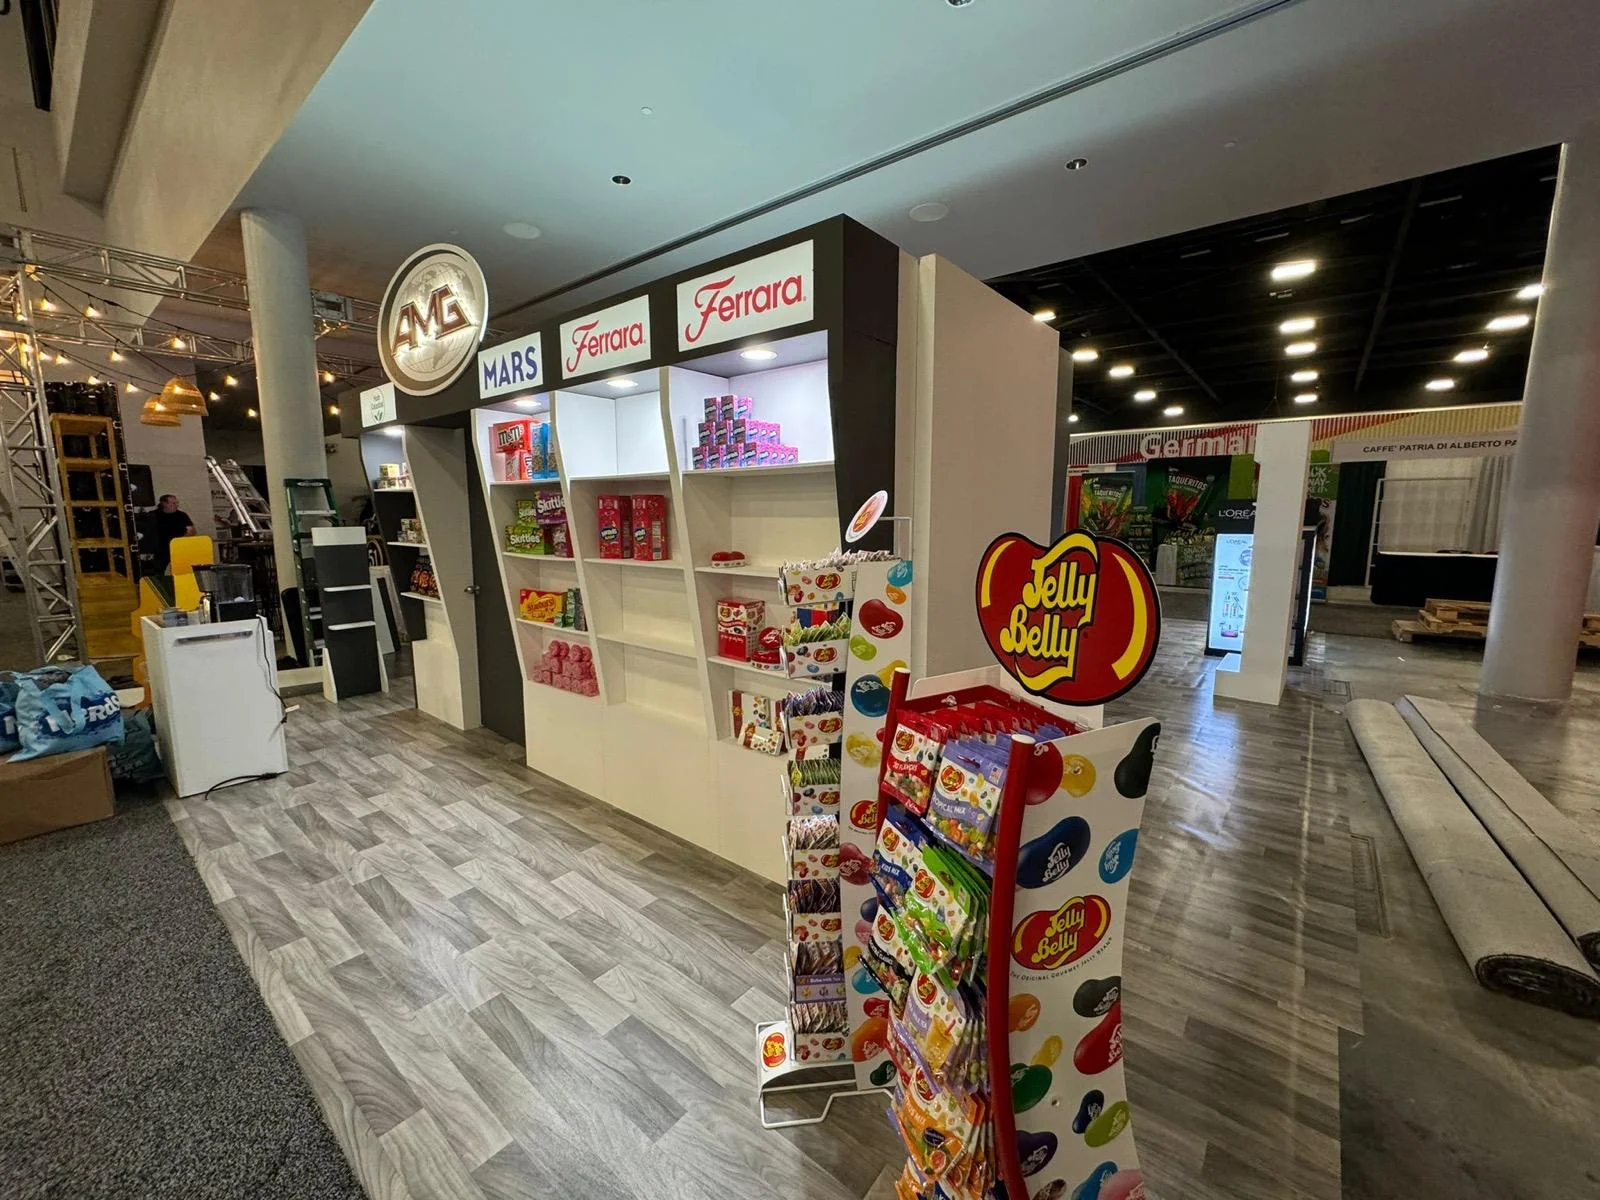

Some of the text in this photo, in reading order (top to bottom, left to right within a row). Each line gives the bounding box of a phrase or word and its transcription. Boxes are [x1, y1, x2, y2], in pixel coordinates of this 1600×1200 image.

[391, 284, 472, 358] AMG
[685, 275, 804, 343] Ferrara
[566, 320, 644, 373] Ferrara
[483, 346, 538, 390] MARS
[1400, 443, 1434, 451] PATRIA
[1450, 440, 1501, 449] ALBERTO
[1168, 475, 1208, 491] TAQUERITOS
[537, 496, 567, 514] Skittle
[1218, 509, 1257, 518] L'ORÉA
[510, 533, 540, 545] Skittles
[1022, 533, 1098, 627] Jelly
[1000, 604, 1078, 690] Belly
[1042, 859, 1070, 882] Belly
[1047, 842, 1072, 869] Jelly
[1045, 896, 1085, 937] Jelly
[1031, 931, 1077, 969] Belly
